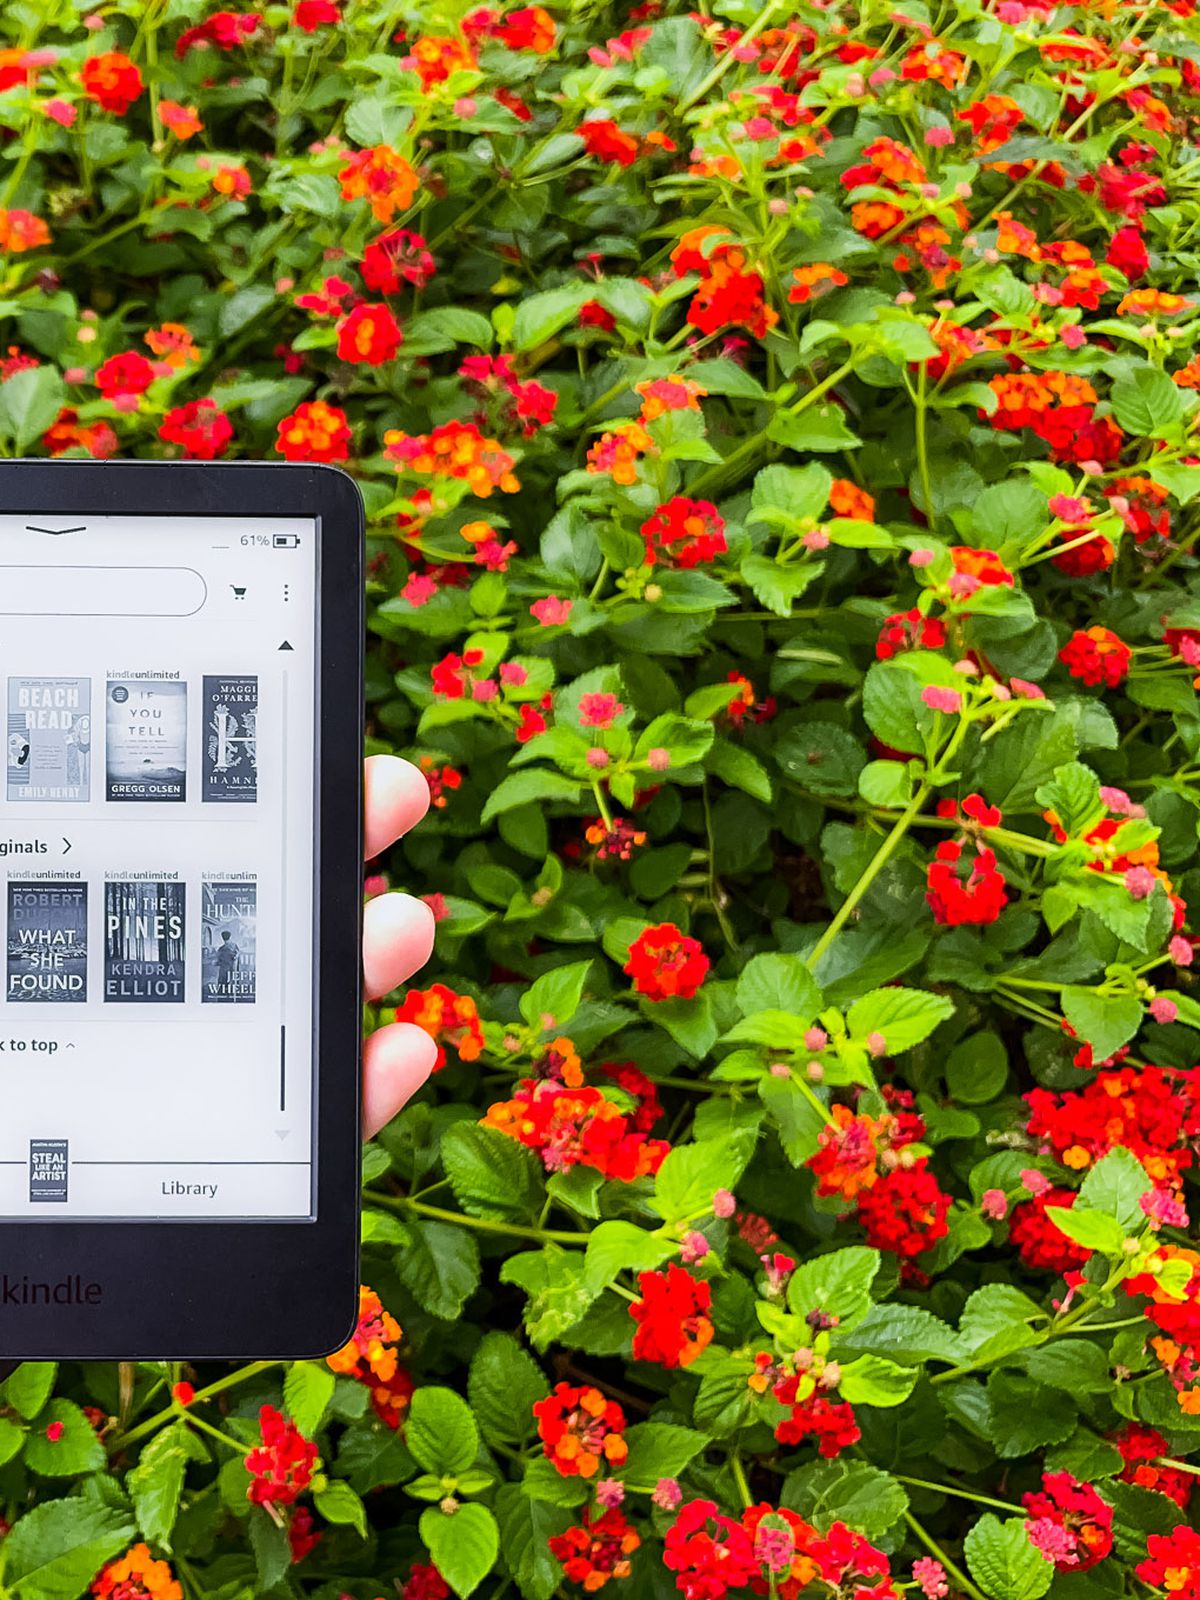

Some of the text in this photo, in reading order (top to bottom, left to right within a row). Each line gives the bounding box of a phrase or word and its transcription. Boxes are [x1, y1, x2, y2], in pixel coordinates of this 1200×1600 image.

[240, 535, 270, 546] 61%
[106, 670, 180, 680] kindleunlimited
[18, 687, 80, 708] BEACH
[141, 691, 155, 701] IF
[25, 710, 72, 730] READ
[130, 709, 162, 719] YOU
[128, 726, 165, 737] TELL
[111, 784, 181, 793] GREGG OLSEN
[7, 870, 81, 879] kindleunlimited
[104, 871, 179, 880] kindleunlimited
[13, 893, 83, 907] ROBERT
[122, 897, 167, 911] IN THE
[107, 915, 182, 939] PINES
[19, 929, 76, 944] WHAT
[30, 952, 64, 968] SHE
[111, 963, 176, 976] KENDRA
[10, 974, 83, 990] FOUND
[106, 980, 181, 996] ELLIOT
[9, 1039, 27, 1051] to
[31, 1039, 58, 1055] top
[32, 1152, 66, 1164] STEAL
[52, 1163, 64, 1171] AN
[32, 1171, 66, 1181] ARTIST
[161, 1180, 218, 1199] Library
[2, 1274, 103, 1305] kindle
